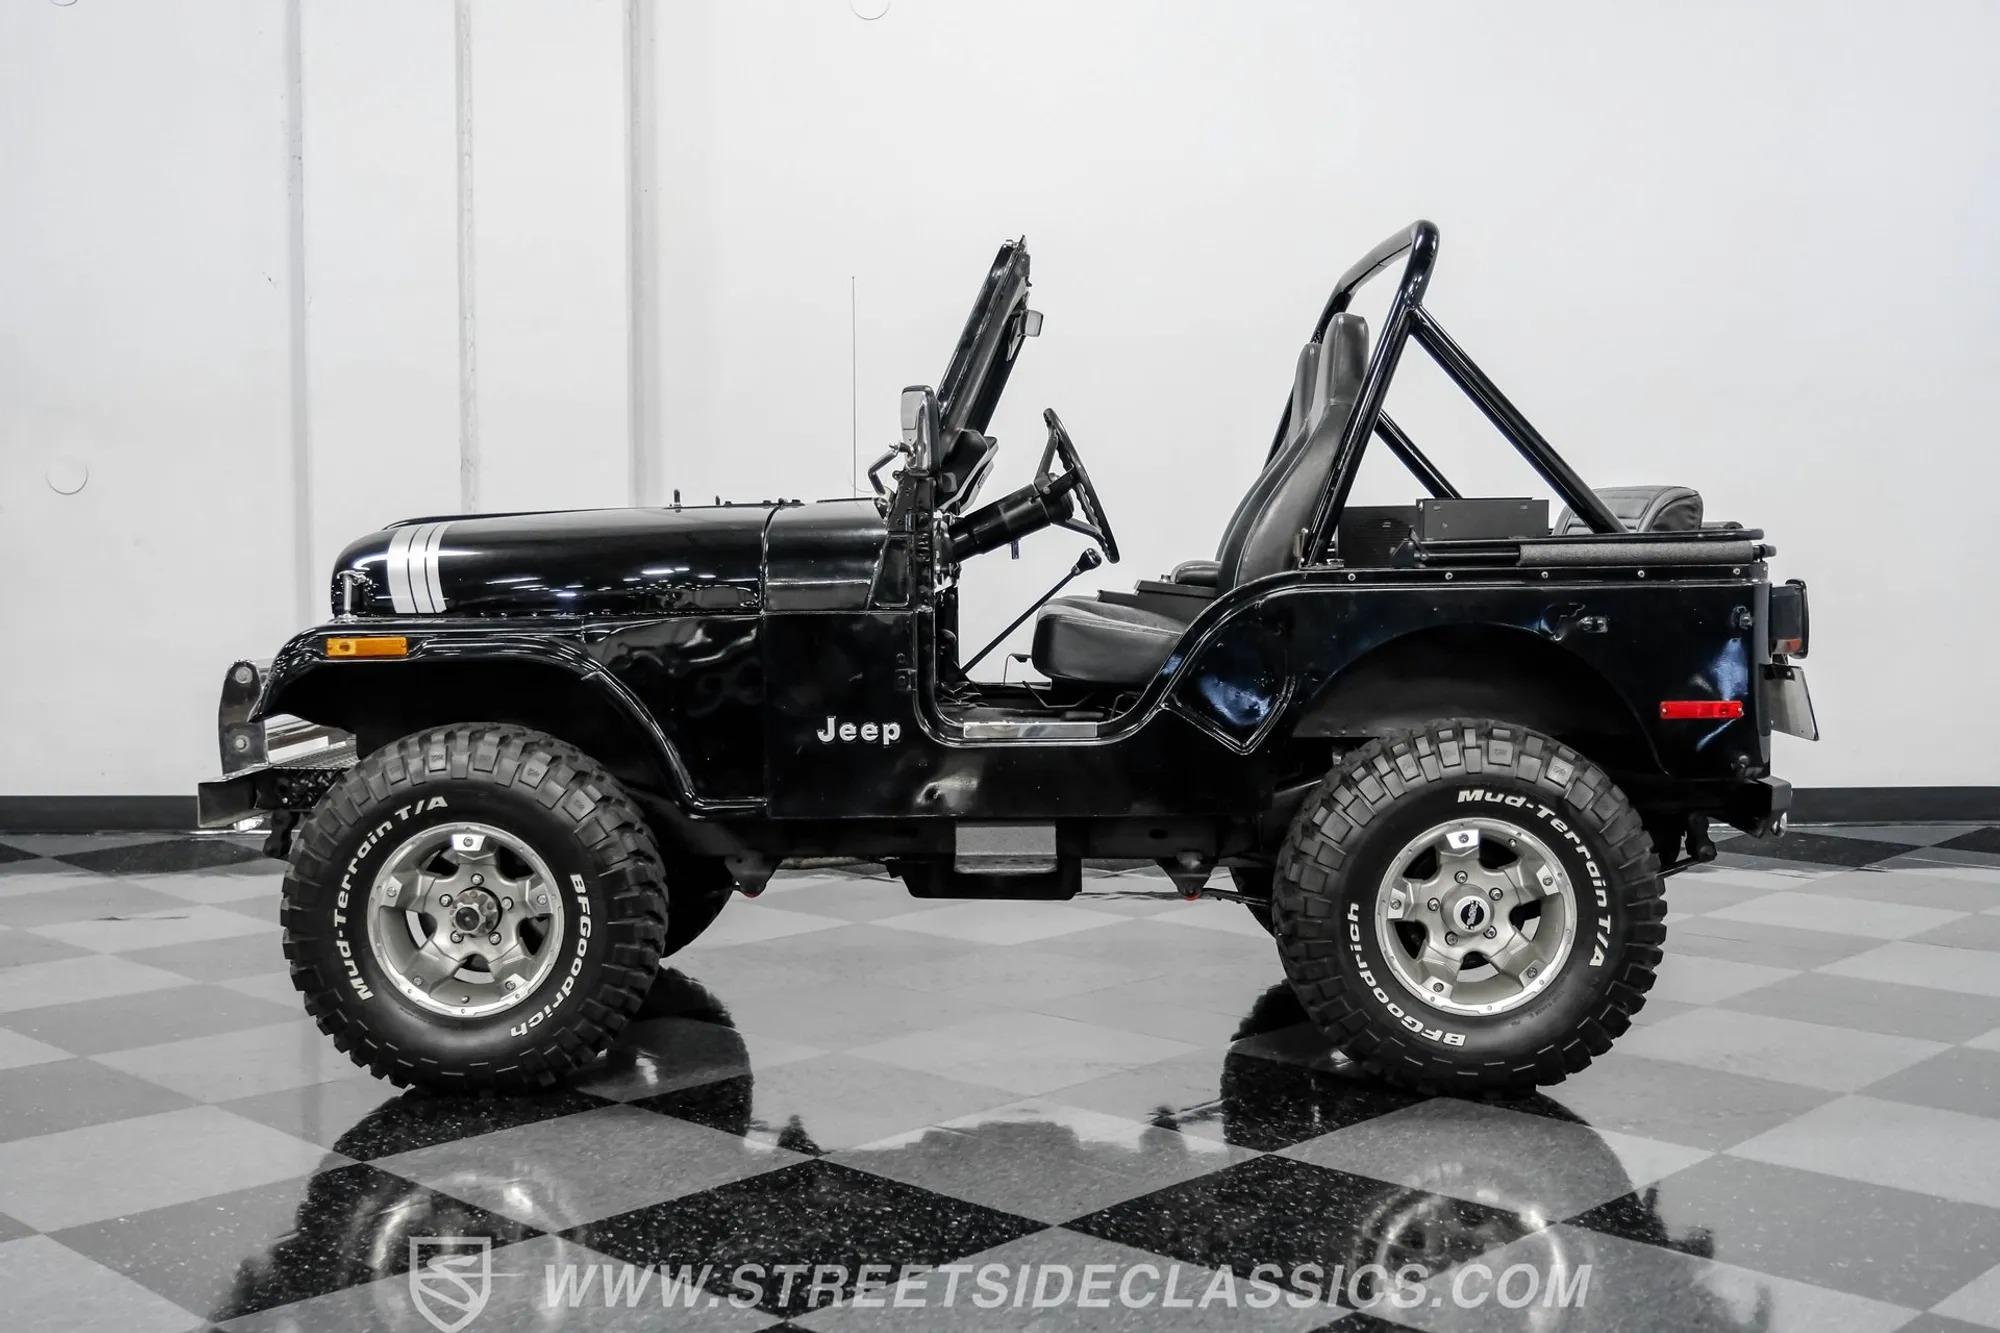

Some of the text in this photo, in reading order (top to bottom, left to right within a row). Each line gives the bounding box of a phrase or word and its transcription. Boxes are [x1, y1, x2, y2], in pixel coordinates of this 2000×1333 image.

[817, 715, 901, 745] Jeep
[333, 796, 449, 1001] Mud-Terrain T/A
[510, 873, 593, 1039] BFGoodrich
[1457, 788, 1608, 906] Mud-Terrain
[1589, 914, 1612, 968] T/A
[1346, 902, 1466, 1047] BFGoodrich
